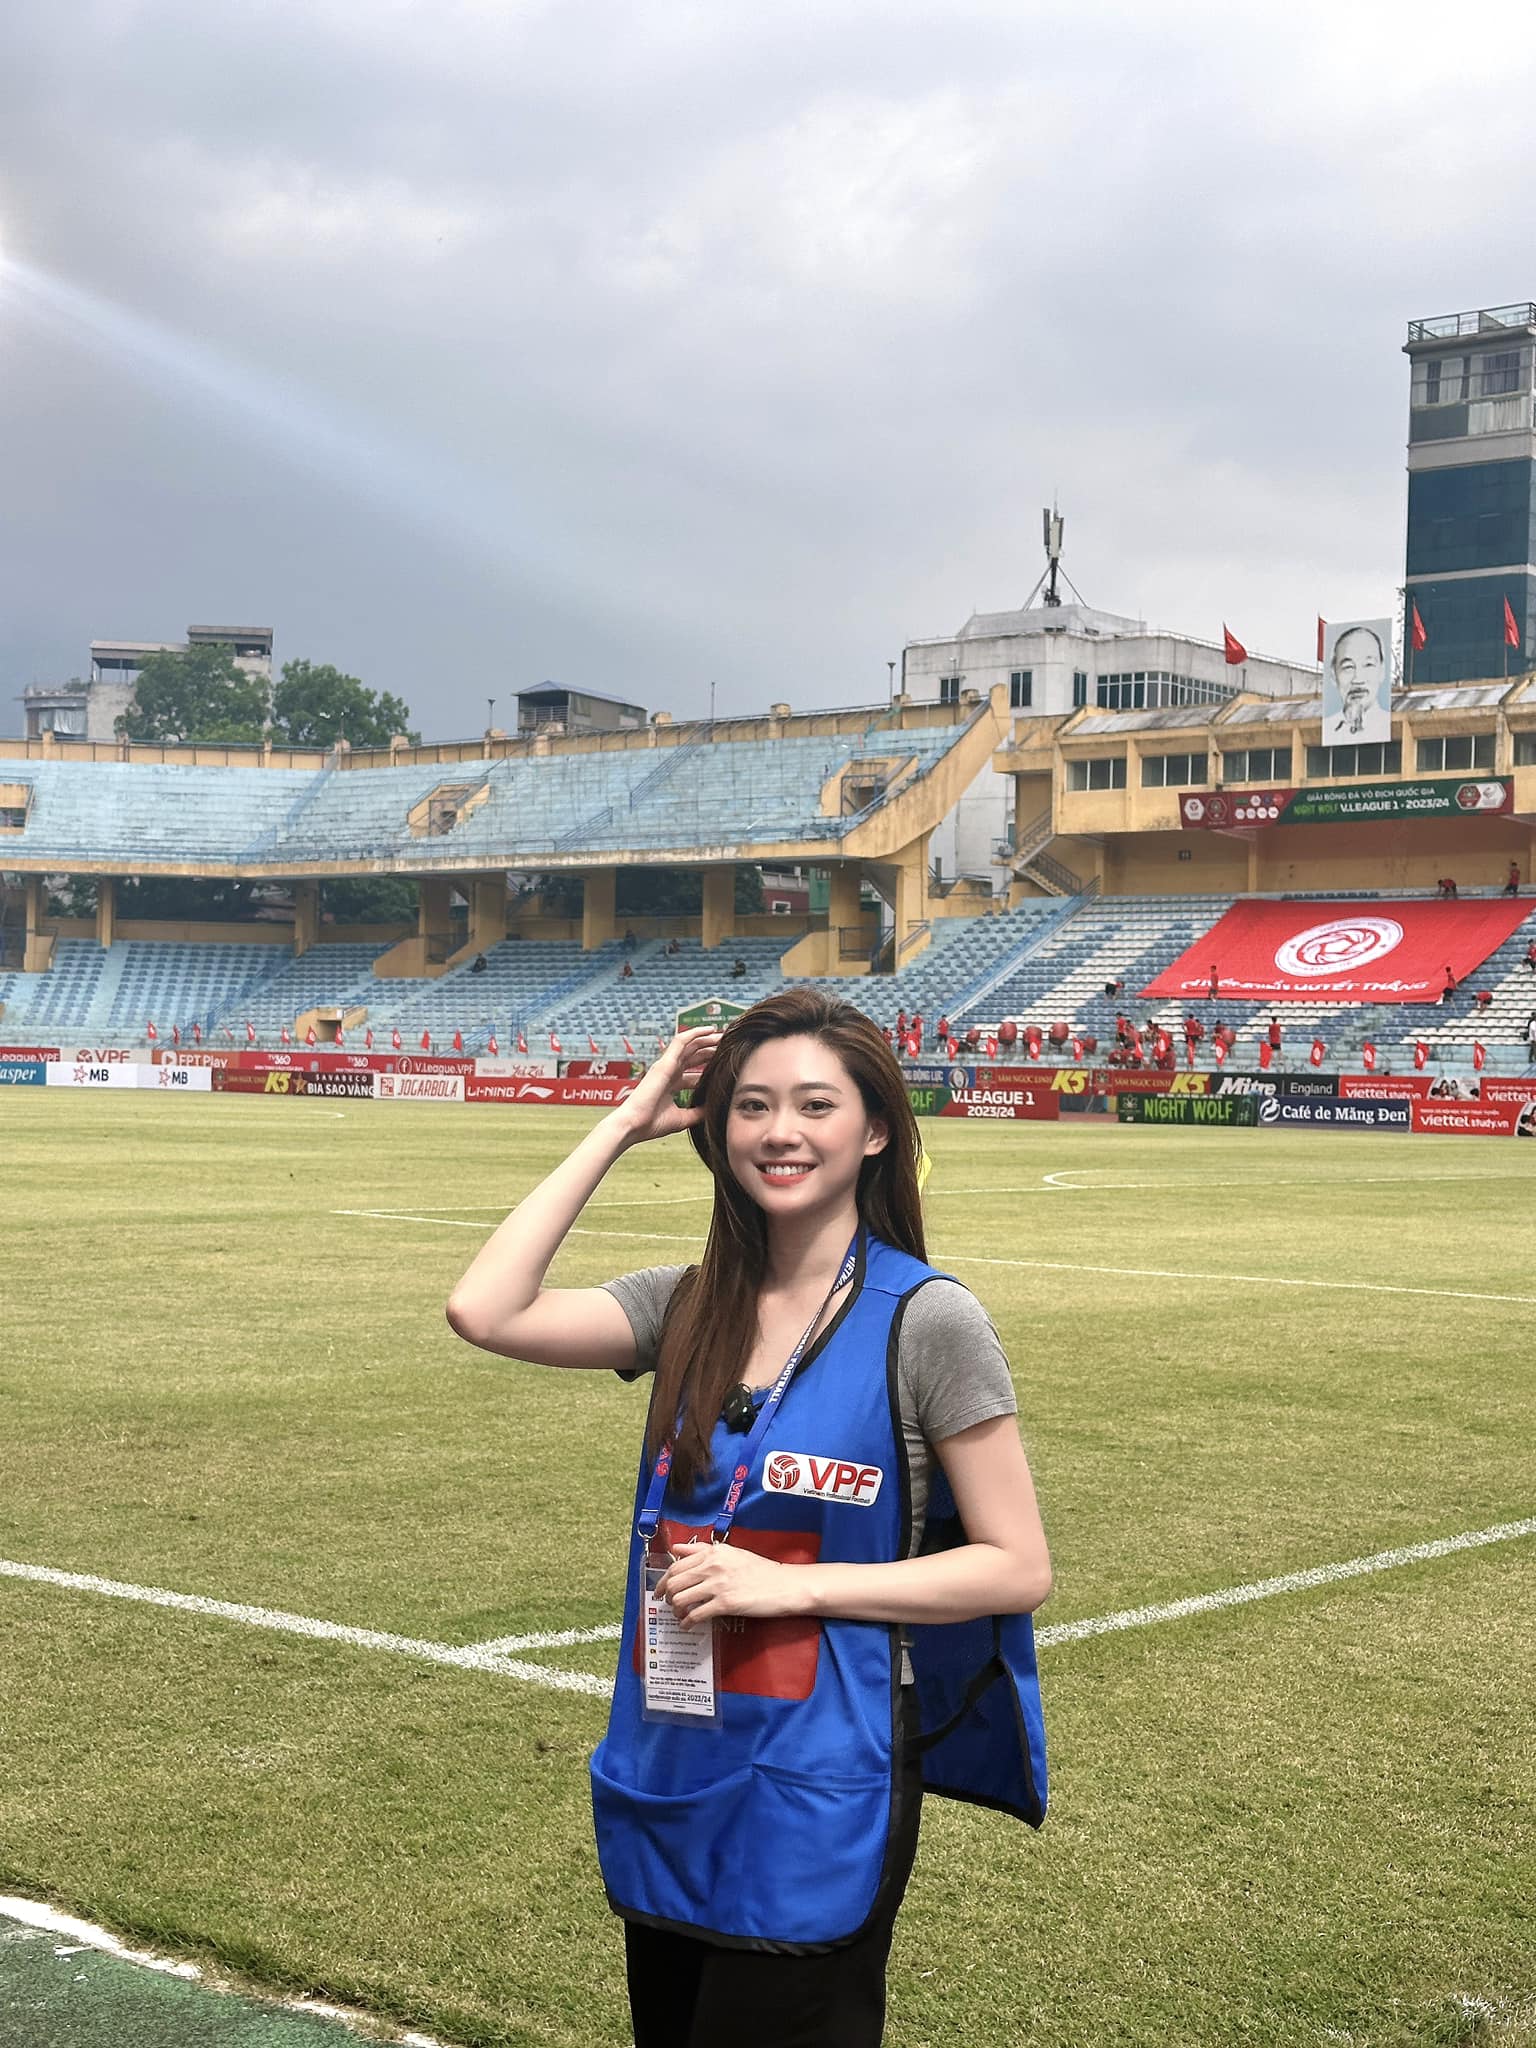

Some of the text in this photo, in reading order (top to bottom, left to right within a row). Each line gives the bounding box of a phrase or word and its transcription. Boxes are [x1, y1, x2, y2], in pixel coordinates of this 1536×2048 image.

[1340, 800, 1391, 813] V.LEAGUE
[1405, 798, 1450, 810] 2023/24
[95, 1049, 131, 1063] VPF
[179, 1054, 229, 1069] FPT Play
[0, 1065, 37, 1084] asper
[89, 1069, 110, 1082] MB
[172, 1071, 189, 1085] MB
[264, 1071, 292, 1094] K5
[1050, 1070, 1089, 1094] K5
[307, 1083, 325, 1095] BIA
[326, 1084, 346, 1096] SAO
[397, 1079, 458, 1097] JOGARBOLA
[467, 1086, 515, 1098] LI-NING
[1169, 1073, 1210, 1094] K5
[1217, 1077, 1277, 1096] Mitre
[1290, 1081, 1333, 1097] England
[562, 1088, 613, 1100] LI-NING
[909, 1091, 934, 1108] OLF
[951, 1089, 1035, 1106] V.LEAGUE 1
[967, 1105, 1016, 1119] 2023/24
[1143, 1099, 1187, 1120] NIGHT
[1192, 1100, 1233, 1121] WOLF
[1282, 1104, 1312, 1120] Café
[1314, 1105, 1331, 1121] de
[1334, 1106, 1375, 1125] Măng
[1377, 1108, 1407, 1122] Đen
[768, 1356, 798, 1404] FOOTBALL
[808, 1458, 880, 1497] VPF
